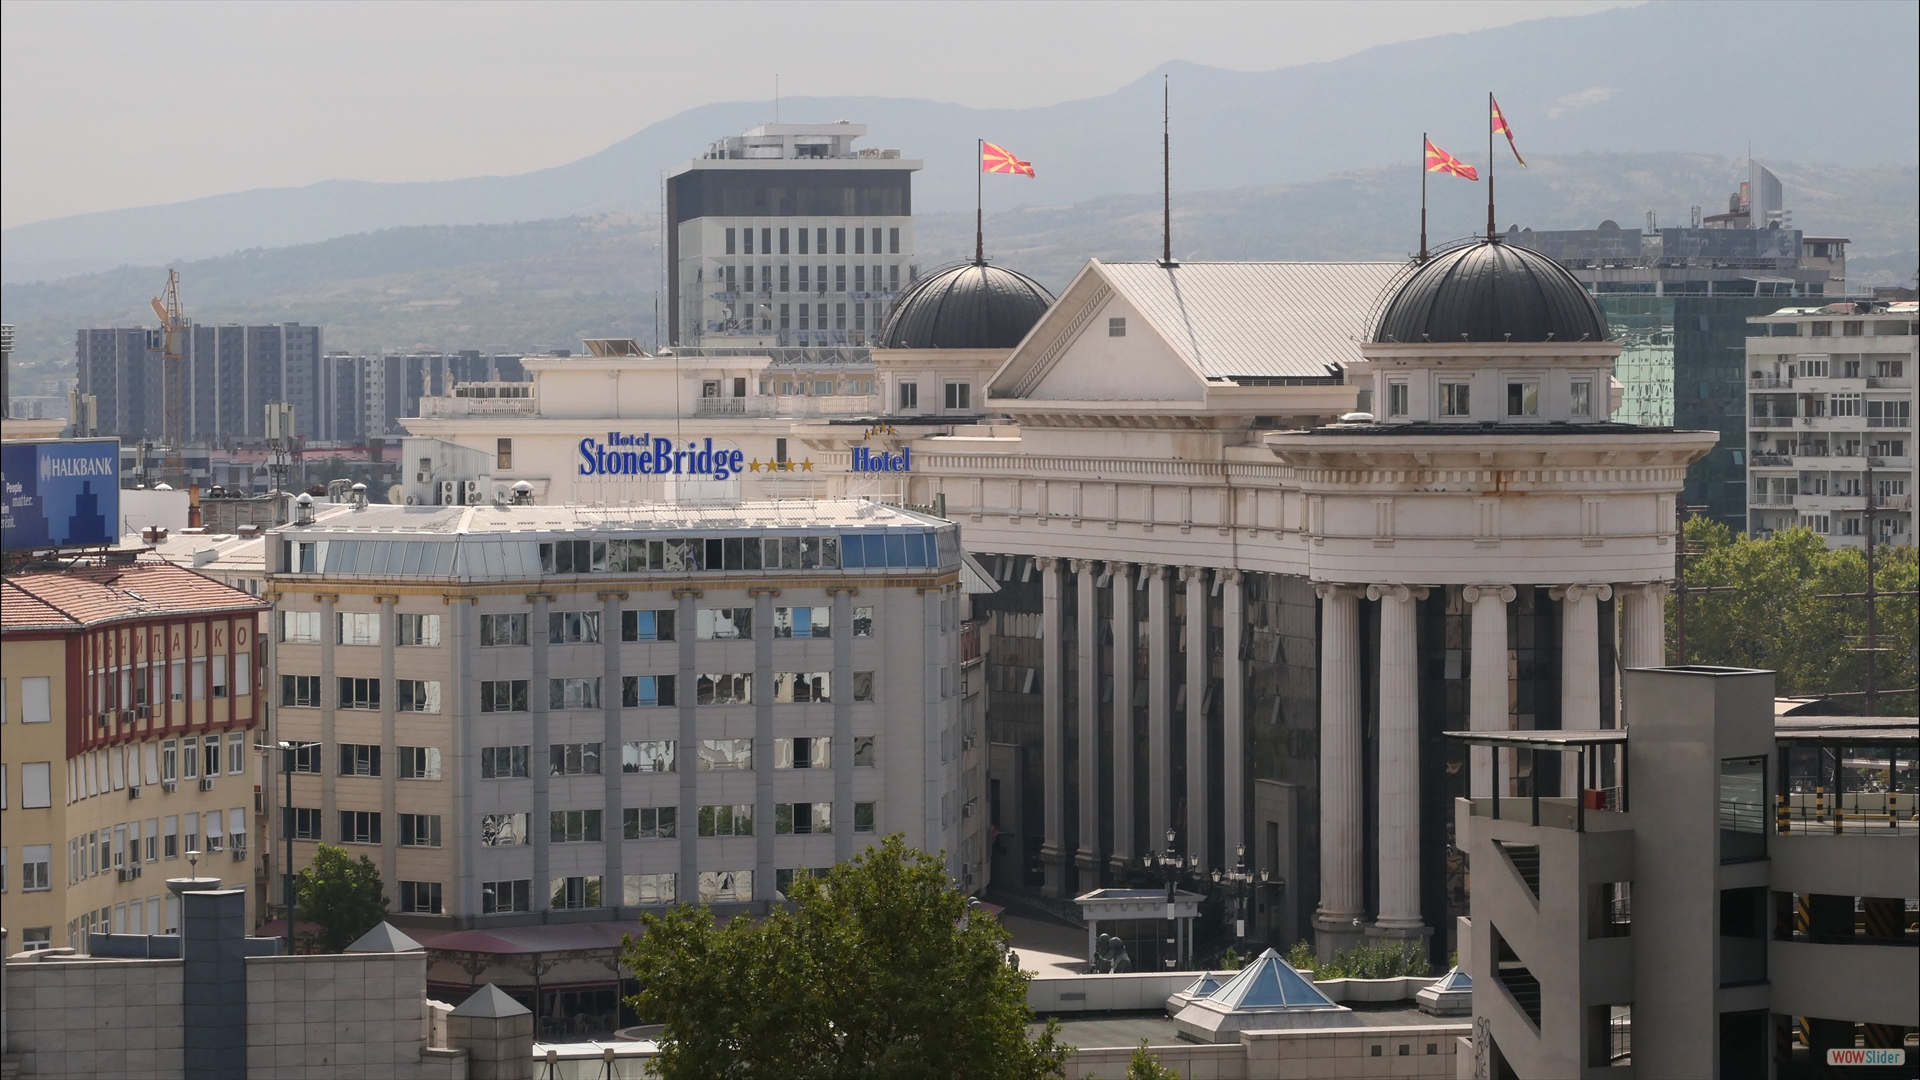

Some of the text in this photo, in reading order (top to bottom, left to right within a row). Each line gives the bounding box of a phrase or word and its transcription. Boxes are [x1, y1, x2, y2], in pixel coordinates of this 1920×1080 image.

[607, 431, 650, 447] Hotel
[52, 457, 112, 476] HALKBANK
[579, 437, 744, 481] StoneBridge
[850, 445, 911, 473] Hotel
[6, 482, 22, 495] People
[12, 495, 33, 507] matter.
